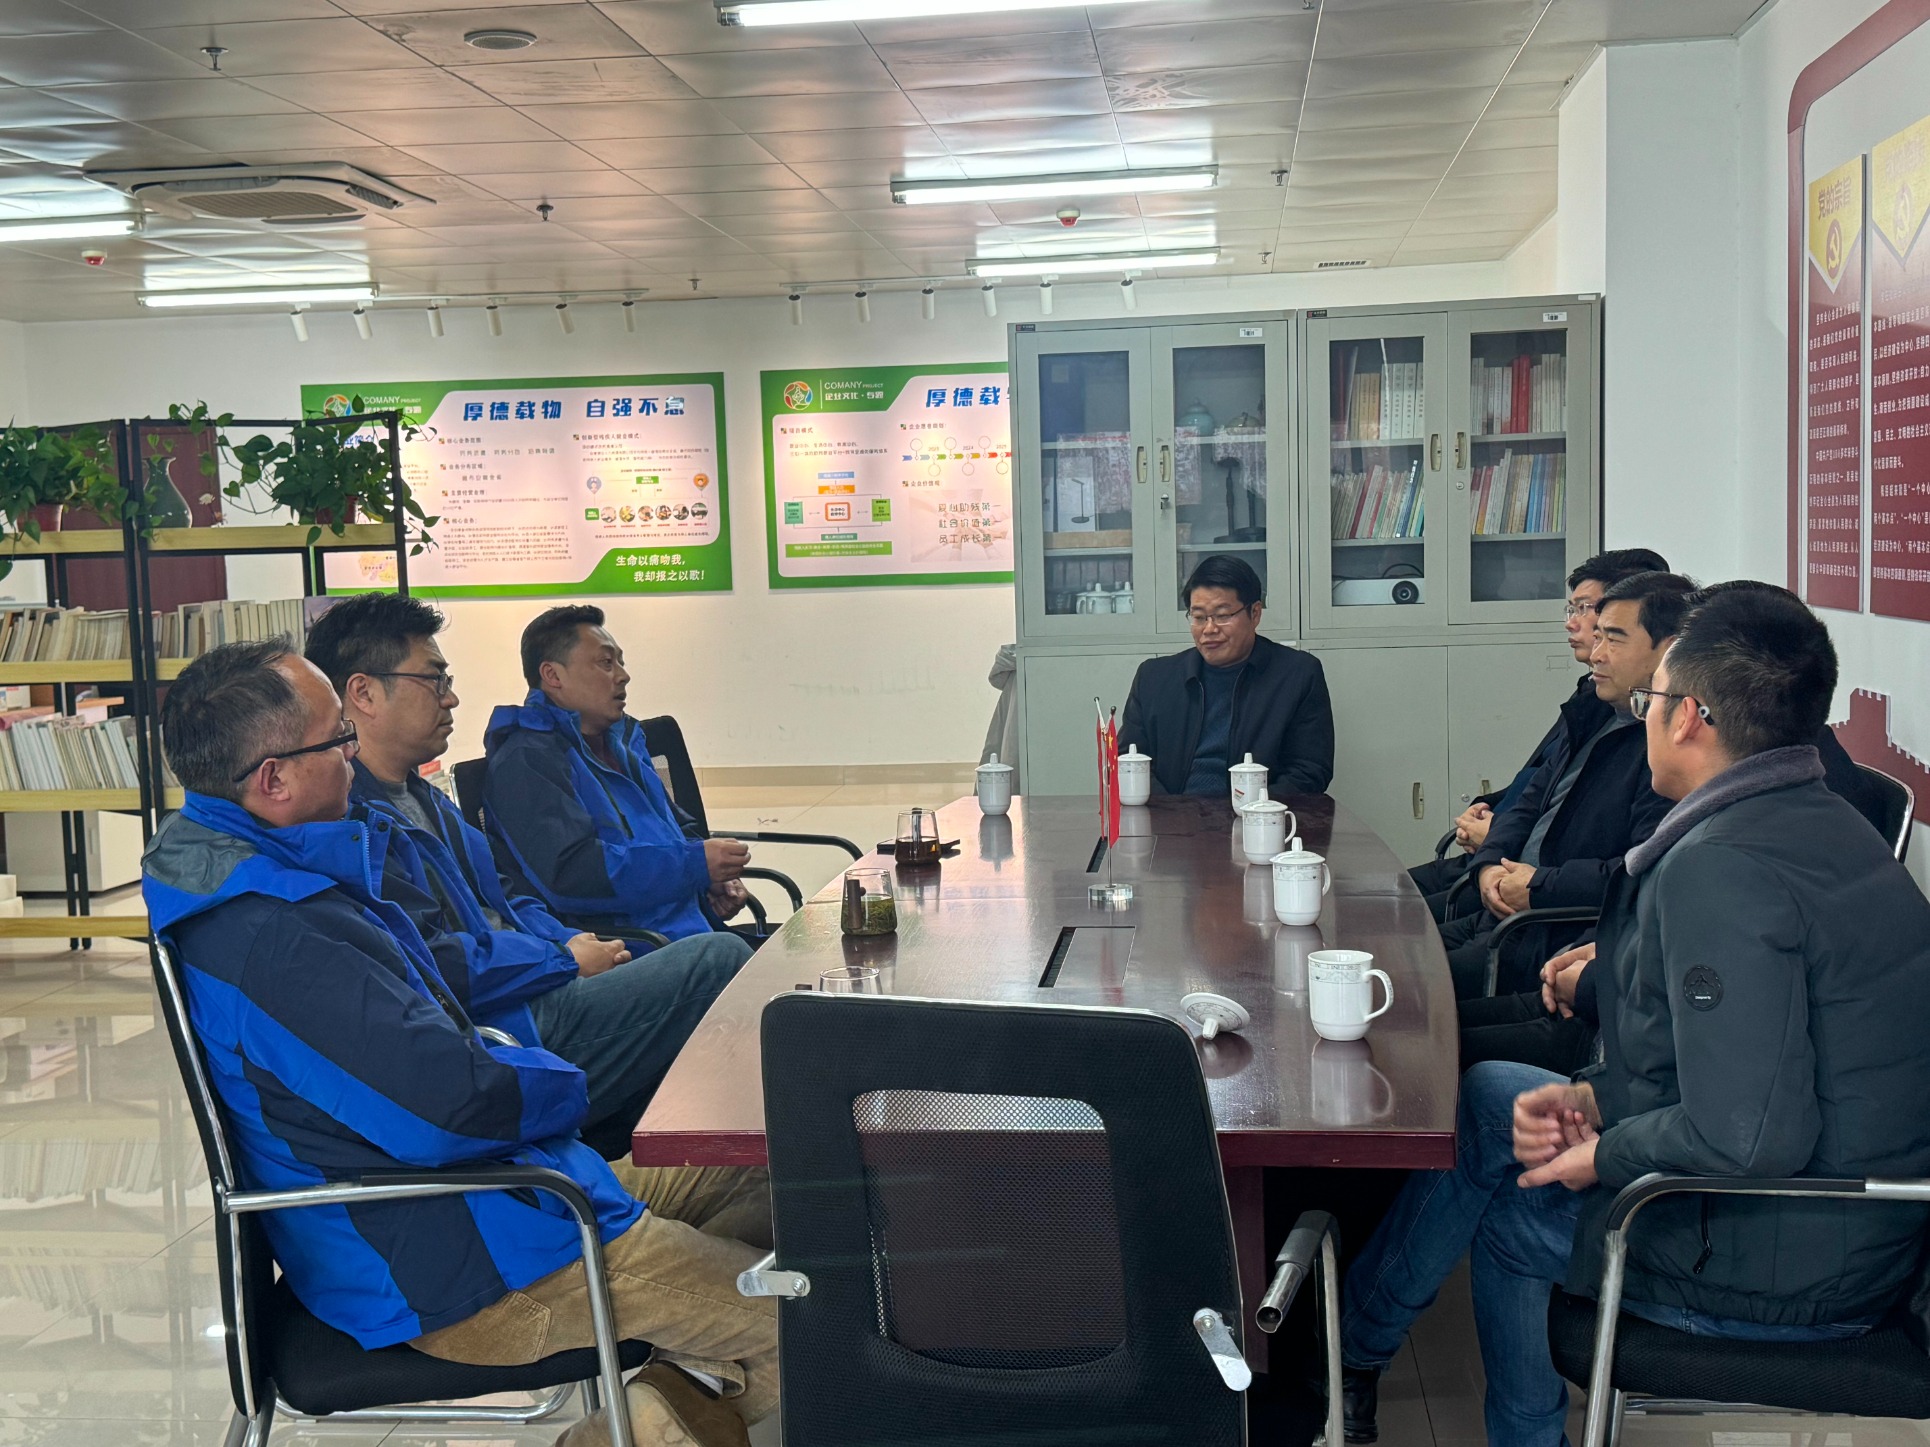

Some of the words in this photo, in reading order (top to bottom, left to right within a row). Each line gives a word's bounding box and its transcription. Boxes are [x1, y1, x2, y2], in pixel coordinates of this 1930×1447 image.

[1818, 175, 1851, 220] 党的宗旨
[824, 381, 862, 390] COMANY
[363, 396, 400, 404] COMANY
[925, 386, 1011, 408] 厚德载
[462, 399, 562, 421] 厚德载物
[585, 395, 686, 418] 自强不息
[938, 518, 1002, 528] 社会价值第一
[939, 533, 1002, 544] 员工成长第一
[615, 553, 686, 566] 生命以痛吻我，
[633, 569, 705, 582] 我却报之以歌！
